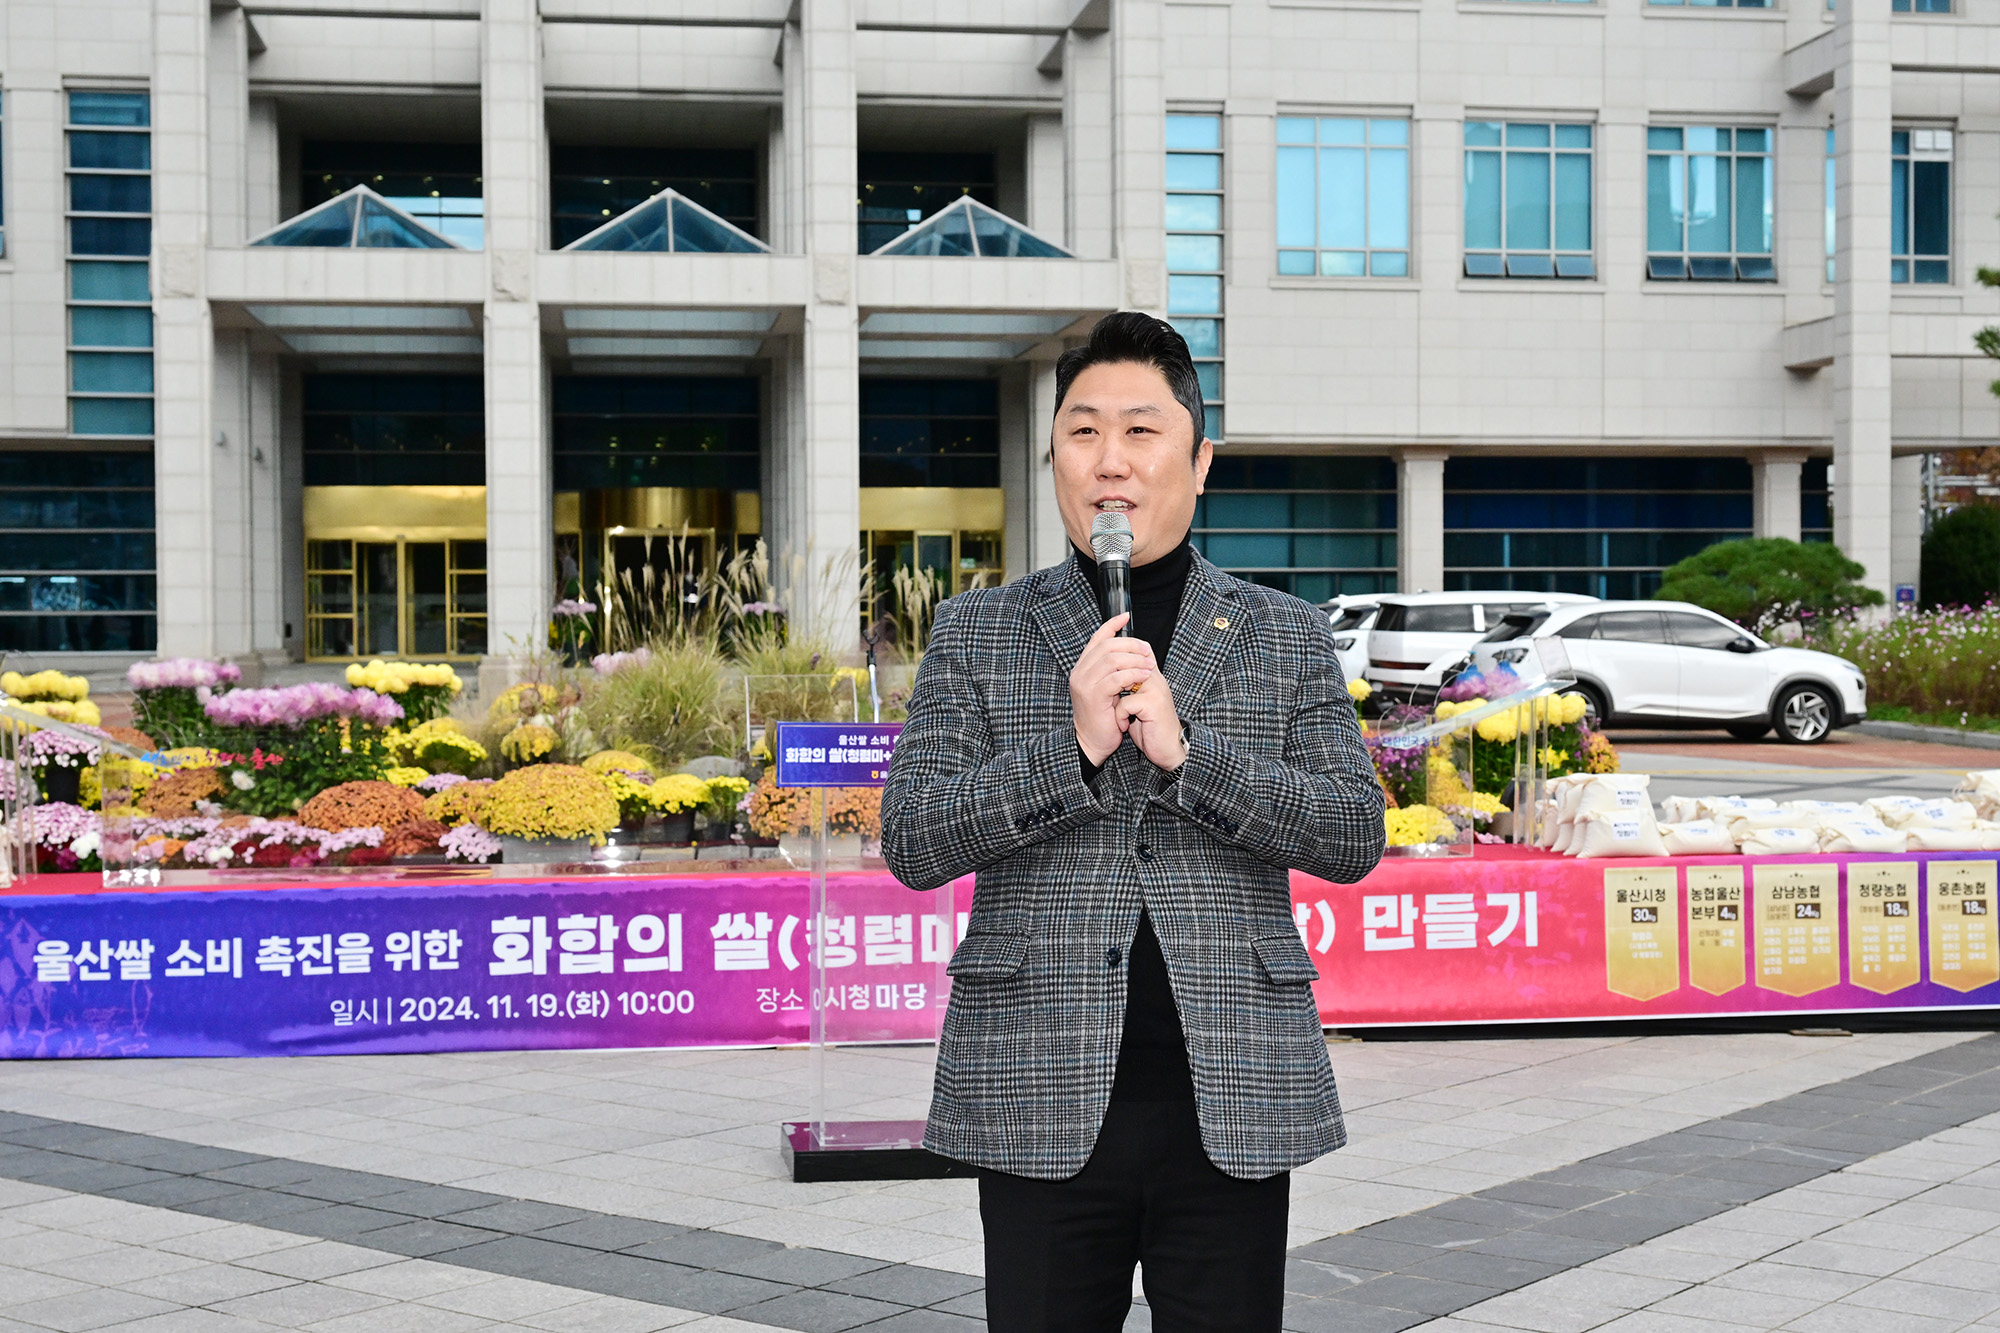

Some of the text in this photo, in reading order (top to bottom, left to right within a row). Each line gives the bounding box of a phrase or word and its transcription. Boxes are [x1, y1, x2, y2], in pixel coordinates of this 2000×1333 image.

[838, 735, 868, 746] 울산쌀
[870, 735, 890, 746] 소비
[785, 747, 826, 763] 화합의
[1616, 888, 1667, 903] 울산시청
[1690, 887, 1741, 901] 농협울산
[1772, 885, 1820, 900] 삼남농협
[1860, 883, 1907, 897] 청량농협
[1939, 882, 1986, 896] 웅촌농협
[1691, 906, 1716, 920] 본부
[33, 936, 155, 982] 울산쌀
[165, 936, 243, 979] 소비
[255, 932, 374, 977] 촉진을
[384, 928, 463, 971] 위한
[489, 913, 683, 976] 화합의
[1362, 891, 1539, 952] 만들기
[756, 986, 805, 1012] 장소
[329, 998, 378, 1027] 일시
[400, 995, 480, 1023] 2024.
[487, 994, 519, 1019] 11.
[526, 990, 610, 1019] 19.(화)
[618, 990, 695, 1016] 10:00
